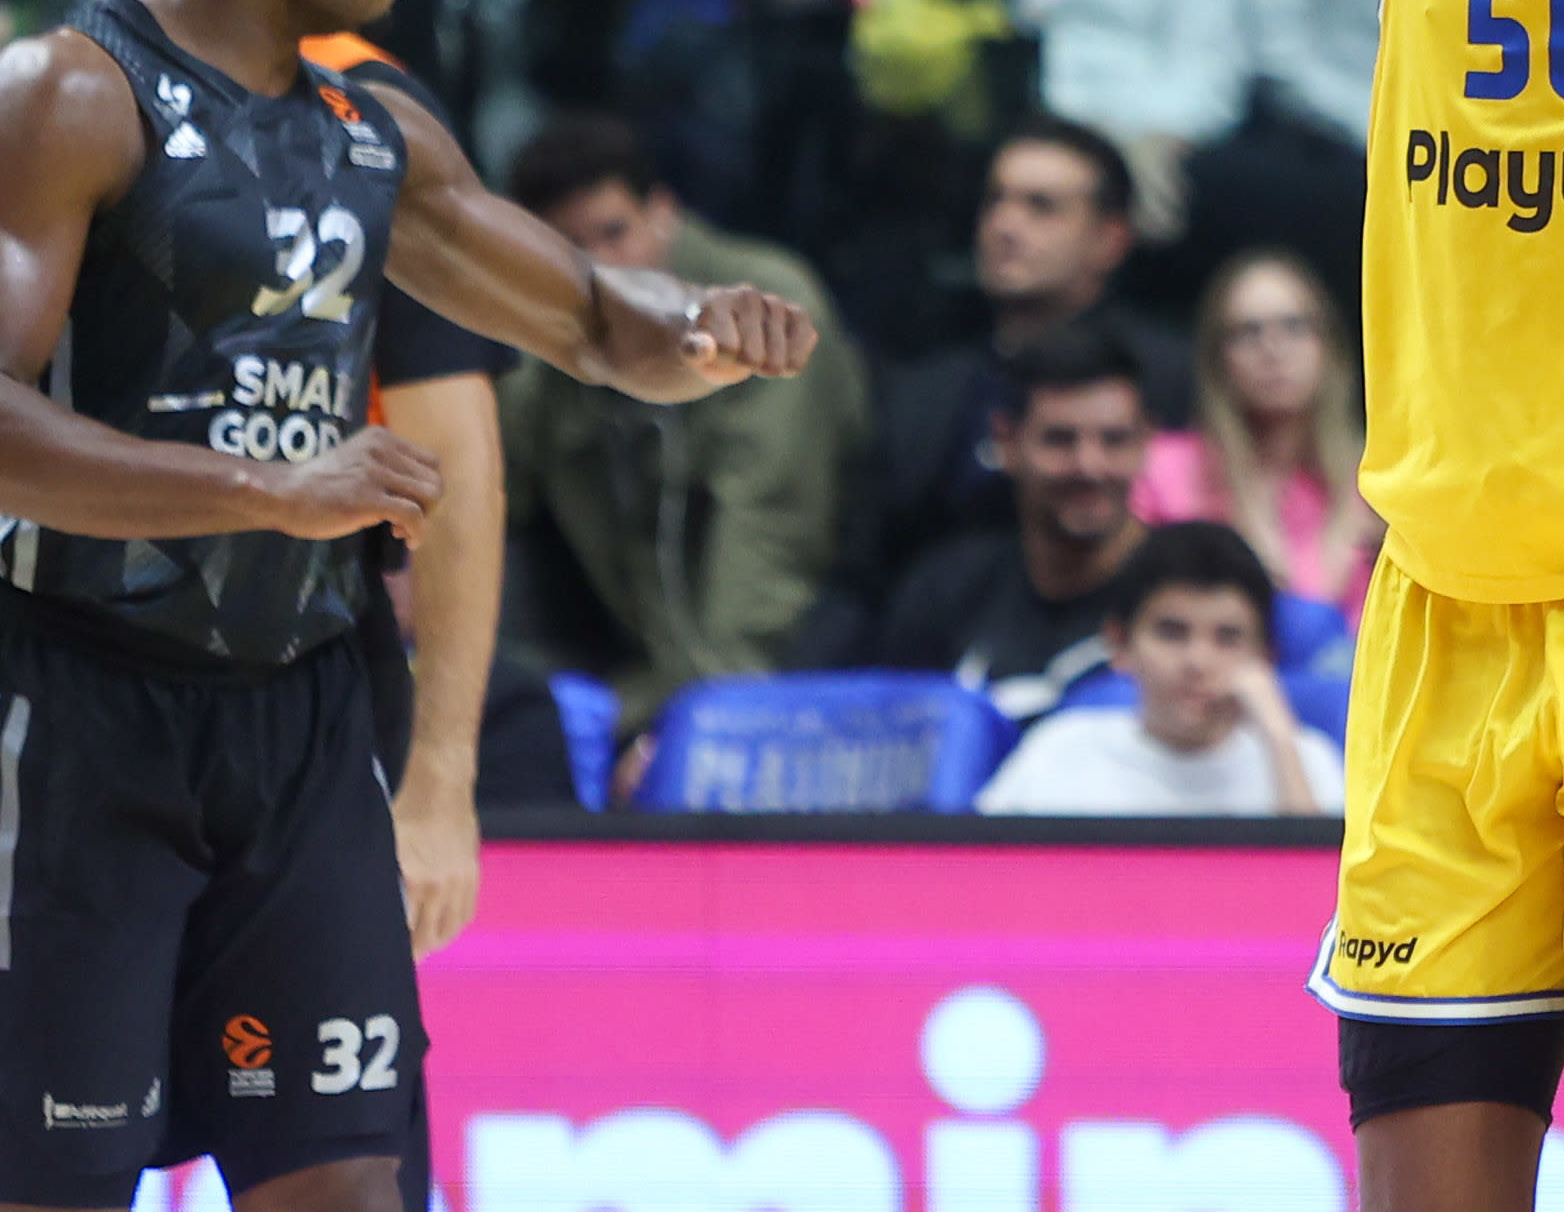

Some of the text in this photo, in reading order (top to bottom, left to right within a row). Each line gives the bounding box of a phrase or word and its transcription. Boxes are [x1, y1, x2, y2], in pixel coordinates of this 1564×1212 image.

[251, 205, 366, 325] 32
[1338, 930, 1418, 968] Rapyd
[310, 1012, 401, 1095] 32
